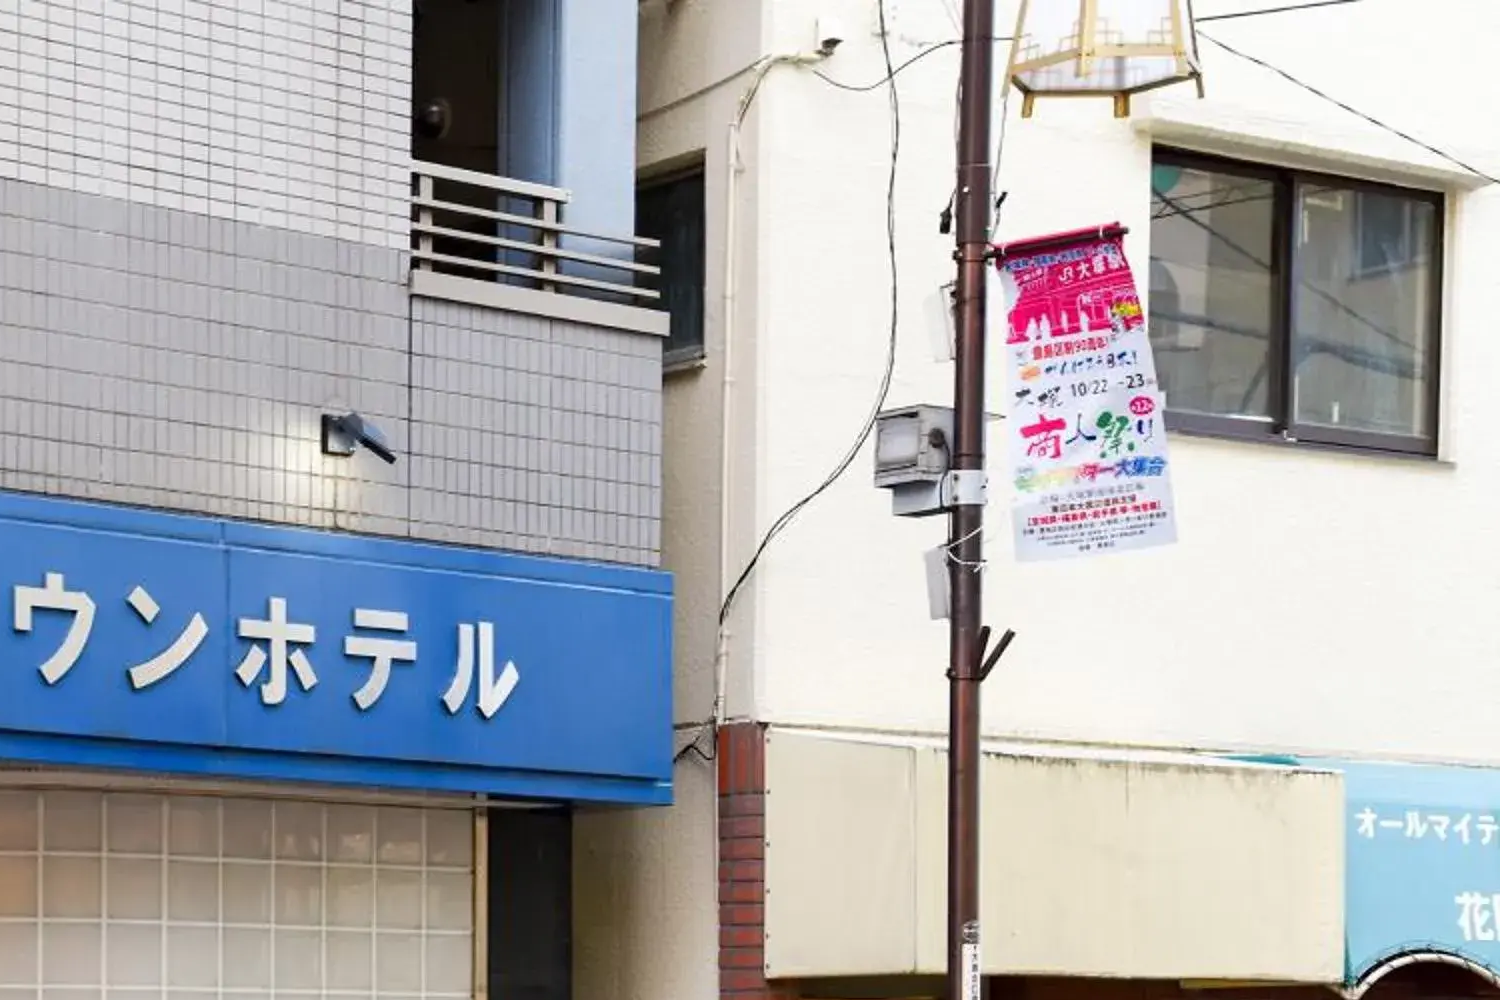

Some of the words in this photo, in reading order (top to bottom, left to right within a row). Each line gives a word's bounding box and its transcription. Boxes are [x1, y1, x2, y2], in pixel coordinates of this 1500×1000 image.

[1019, 410, 1154, 459] 商人祭り
[1354, 806, 1499, 845] オールマイテ
[1454, 891, 1500, 941] 花
